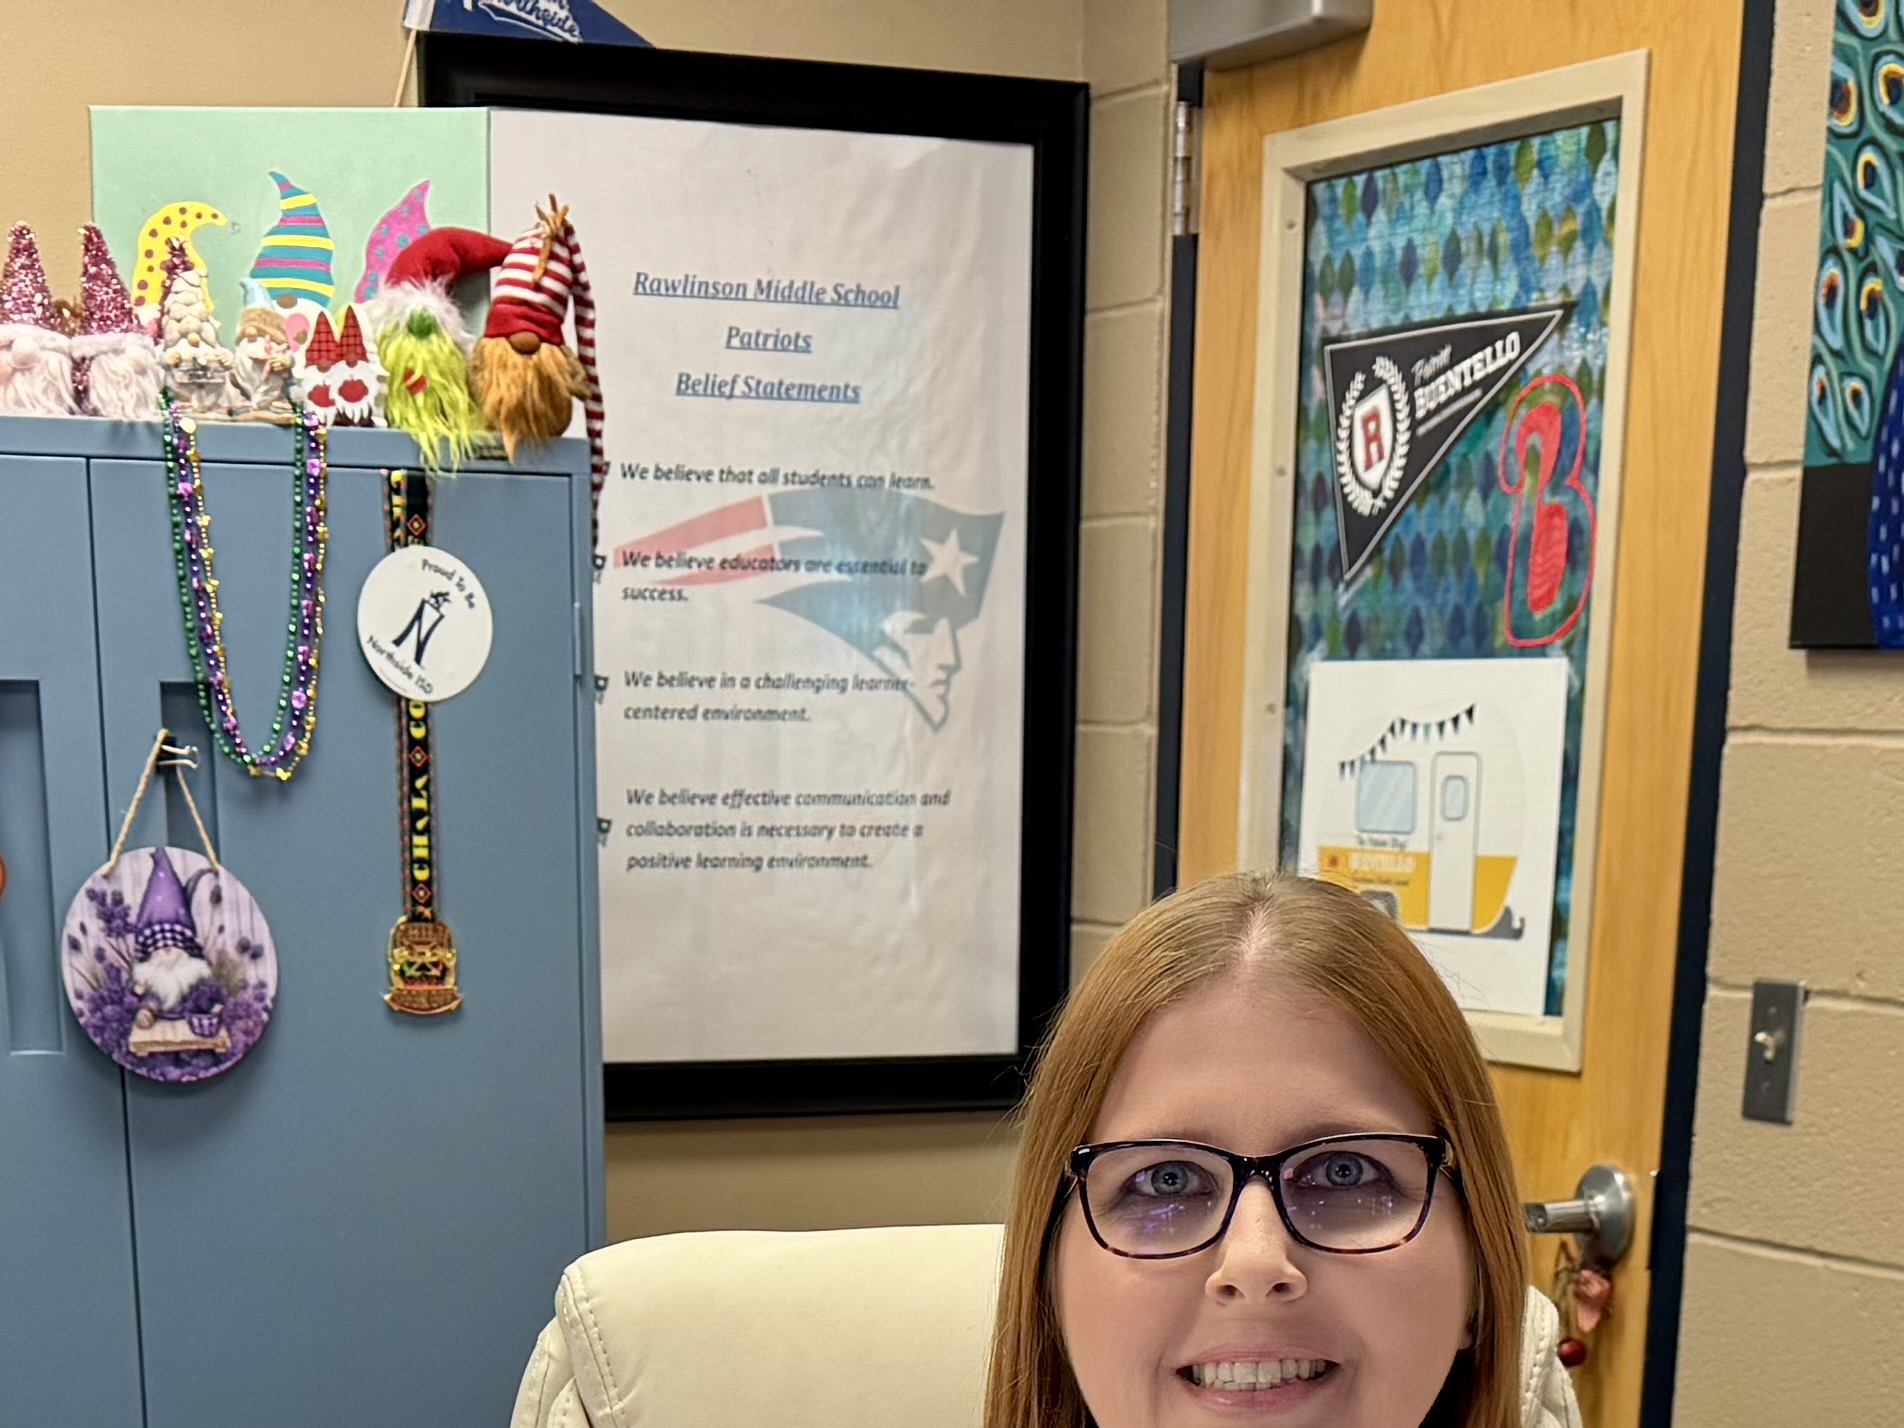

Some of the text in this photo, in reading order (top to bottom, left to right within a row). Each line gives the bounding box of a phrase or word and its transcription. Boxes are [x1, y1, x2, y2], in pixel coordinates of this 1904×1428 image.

[633, 271, 900, 309] Rawlinson Middle School
[725, 325, 813, 353] Patriots
[675, 371, 862, 404] Belief Statements
[1413, 331, 1521, 421] BUENTELLO
[1360, 405, 1385, 473] R
[621, 463, 935, 490] We believe that all students can learn.
[421, 558, 457, 582] Proud
[622, 550, 927, 576] We believe educators are essential to
[621, 584, 689, 602] success.
[392, 597, 446, 668] N
[366, 634, 434, 695] Northside ISD
[624, 671, 652, 688] We
[656, 672, 717, 689] believe
[720, 673, 736, 689] in
[739, 677, 751, 689] a
[754, 673, 847, 694] challenging
[624, 704, 811, 722] centered environment.
[626, 789, 951, 810] We believe effective communication and
[626, 820, 924, 842] collaboration is necessary to create a
[626, 854, 873, 873] positive learning environment.
